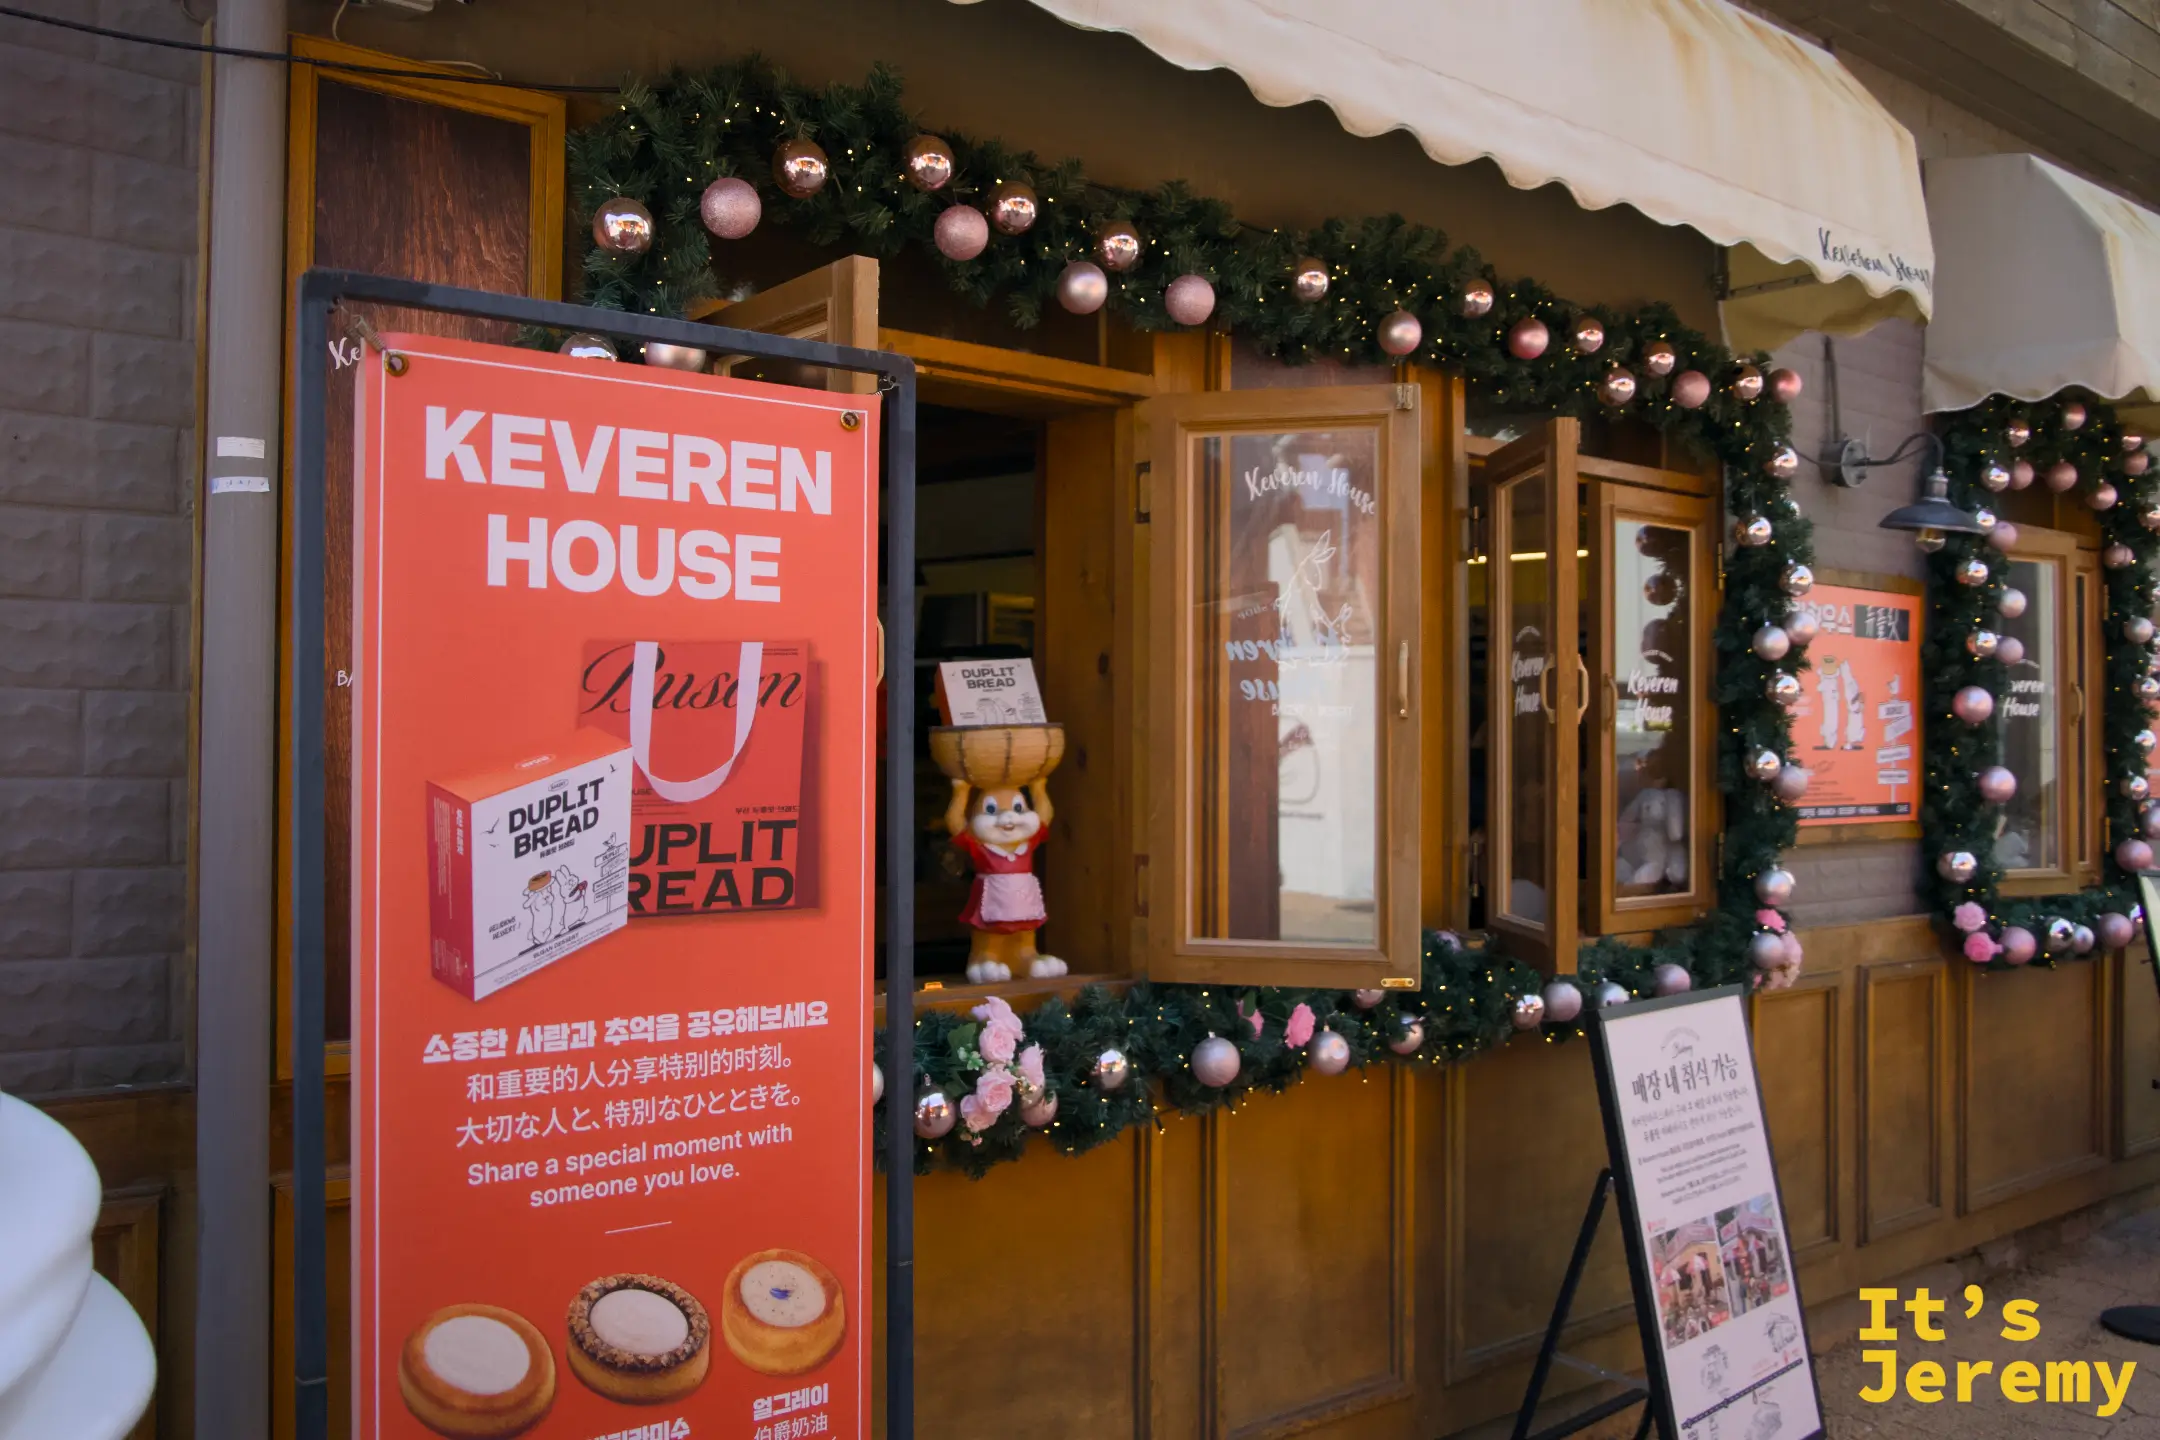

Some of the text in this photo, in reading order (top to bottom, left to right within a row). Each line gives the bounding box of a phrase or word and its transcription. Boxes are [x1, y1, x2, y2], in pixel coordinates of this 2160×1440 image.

[425, 405, 832, 515] KEVEREN
[1244, 466, 1375, 514] Keveren House
[487, 513, 781, 602] HOUSE
[581, 643, 802, 715] Busn
[961, 666, 1015, 679] DUPLIT
[967, 677, 1016, 689] BREAD
[1627, 668, 1679, 694] Keveren
[2010, 680, 2045, 693] veren
[1635, 697, 1672, 726] House
[2003, 697, 2041, 718] House
[509, 777, 604, 834] DUPLIT
[514, 806, 599, 859] BREAD
[629, 819, 797, 867] UPLIT
[628, 866, 794, 913] READ
[422, 1000, 829, 1064] 소중한 사람과 추억을 공유해보세요
[467, 1043, 792, 1103] 和重要的人分享特别的时刻。
[1632, 1053, 1738, 1103] 매장 내 취식 가능
[456, 1080, 800, 1148] 大切な人と、特別なひとときを。
[467, 1123, 793, 1187] Share a special moment with
[530, 1162, 741, 1207] someone you love.
[753, 1383, 828, 1421] 얼그레이
